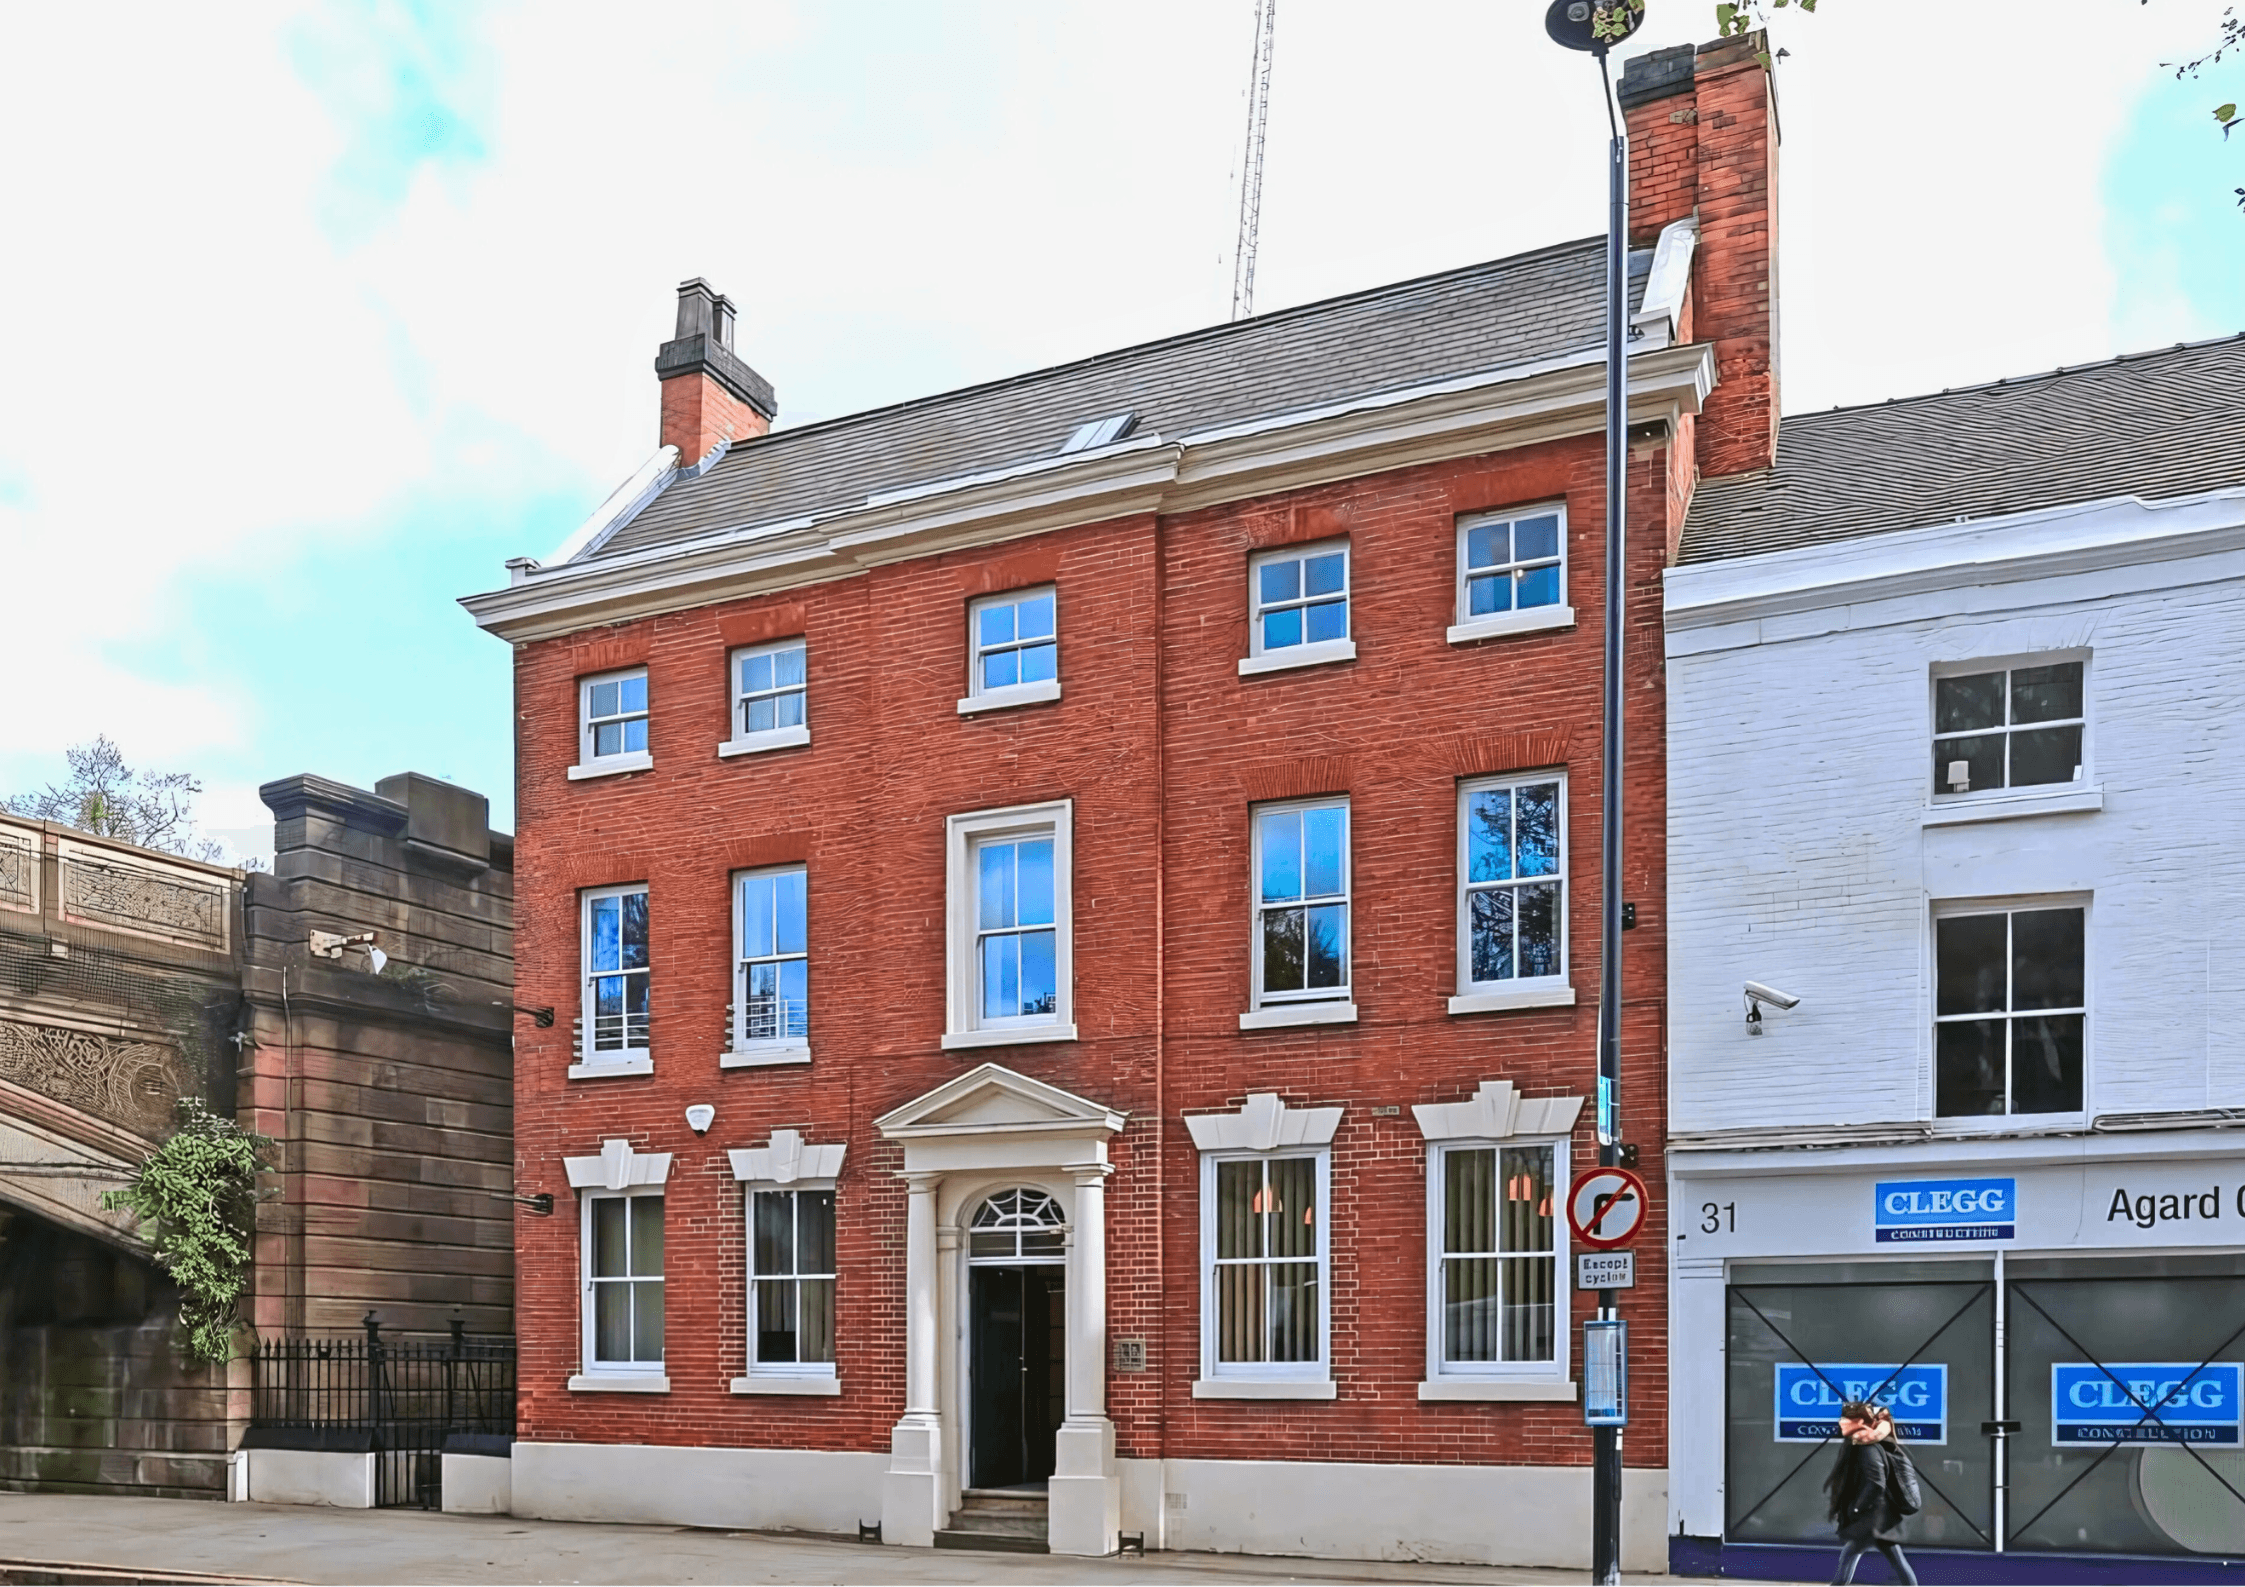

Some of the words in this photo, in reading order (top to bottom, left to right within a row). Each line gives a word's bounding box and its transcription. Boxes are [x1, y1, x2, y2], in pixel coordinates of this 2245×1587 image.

[1884, 1189, 2006, 1215] CLEGG
[2106, 1185, 2220, 1229] Agard
[1701, 1201, 1735, 1235] 31
[2069, 1379, 2224, 1408] CLEGG
